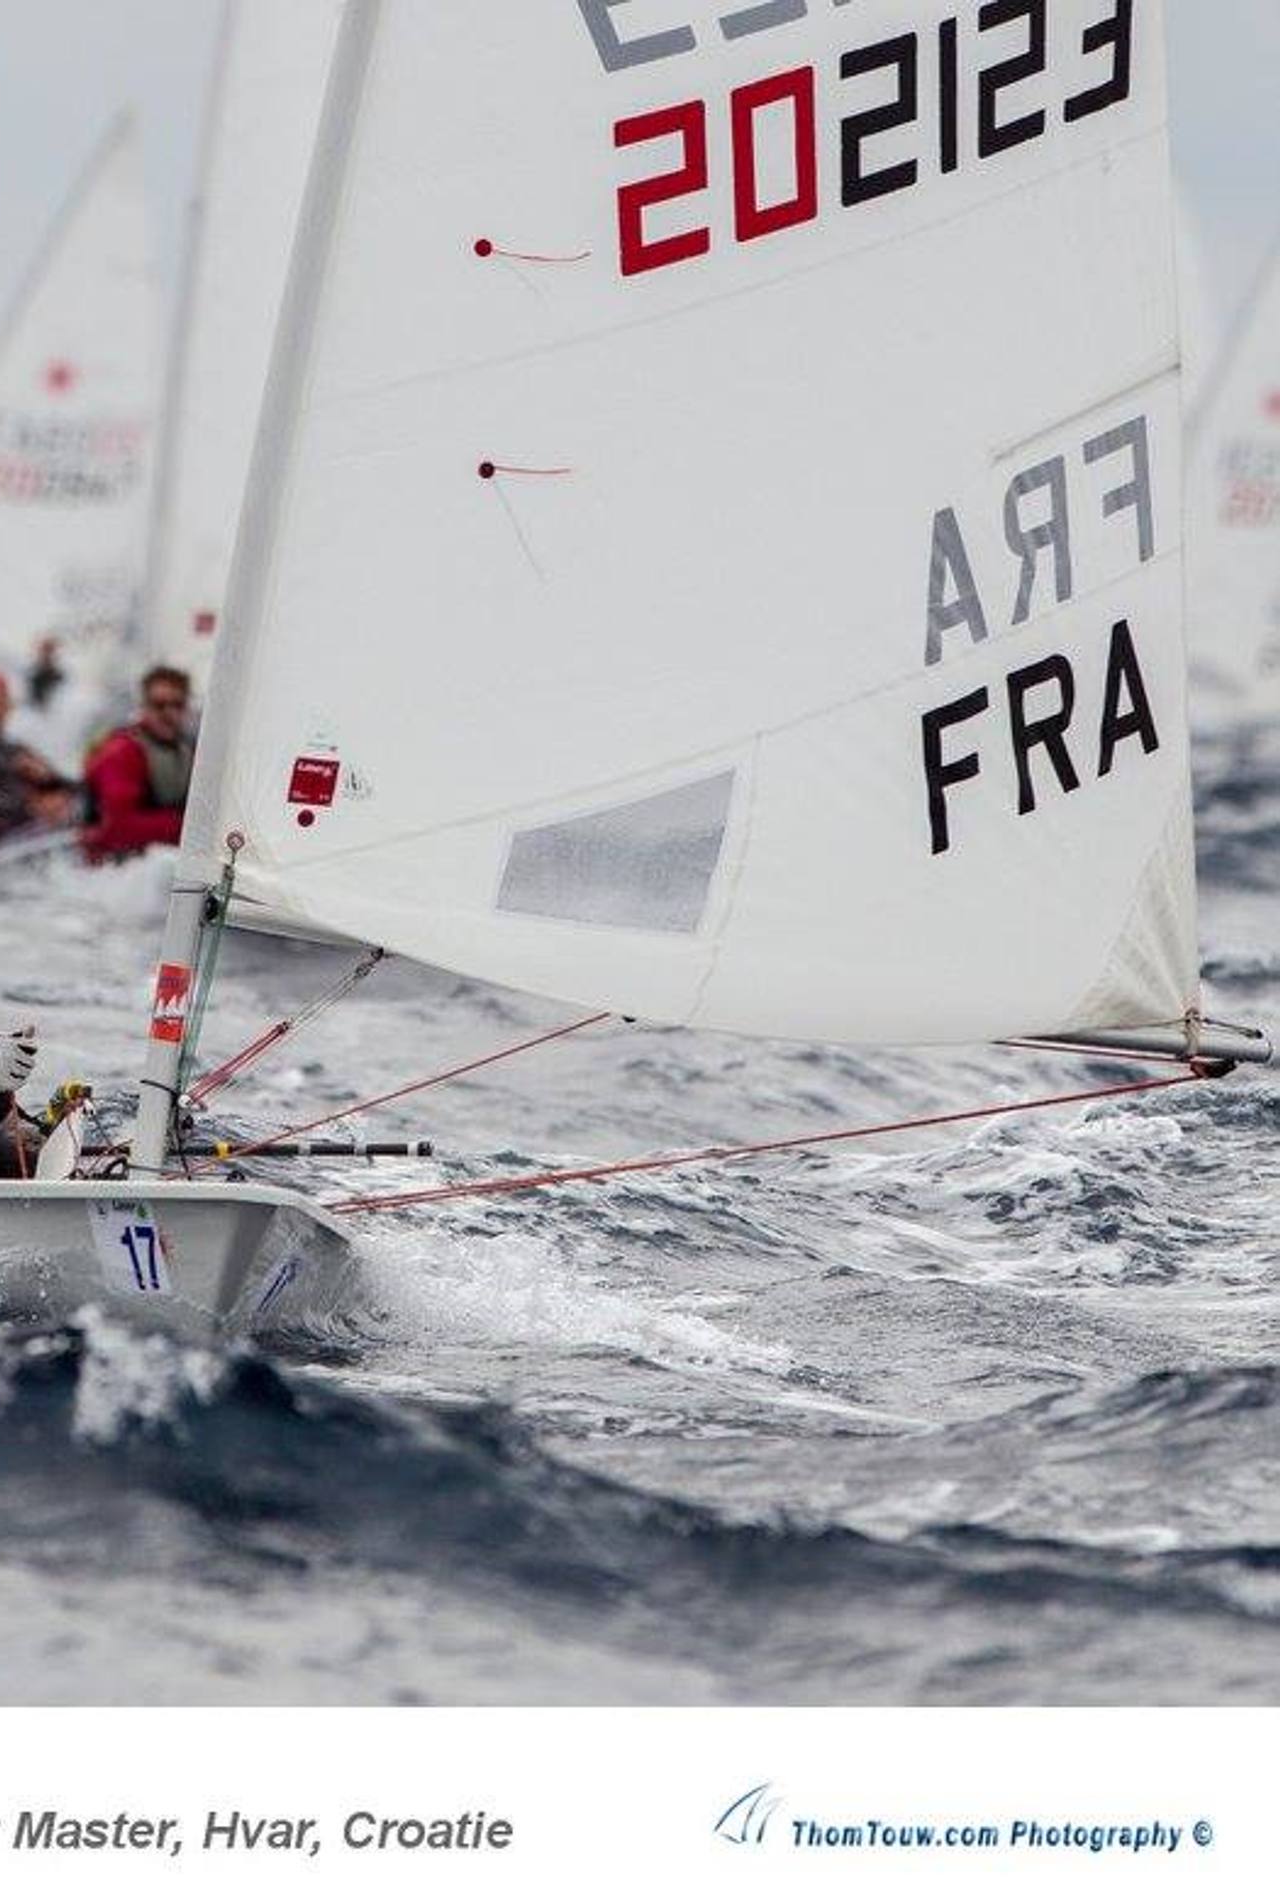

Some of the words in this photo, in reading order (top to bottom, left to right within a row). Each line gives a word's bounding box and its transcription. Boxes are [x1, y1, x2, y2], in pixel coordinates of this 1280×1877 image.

[613, 0, 1133, 277] 202123
[922, 619, 1160, 855] FRA
[121, 1226, 160, 1290] 17
